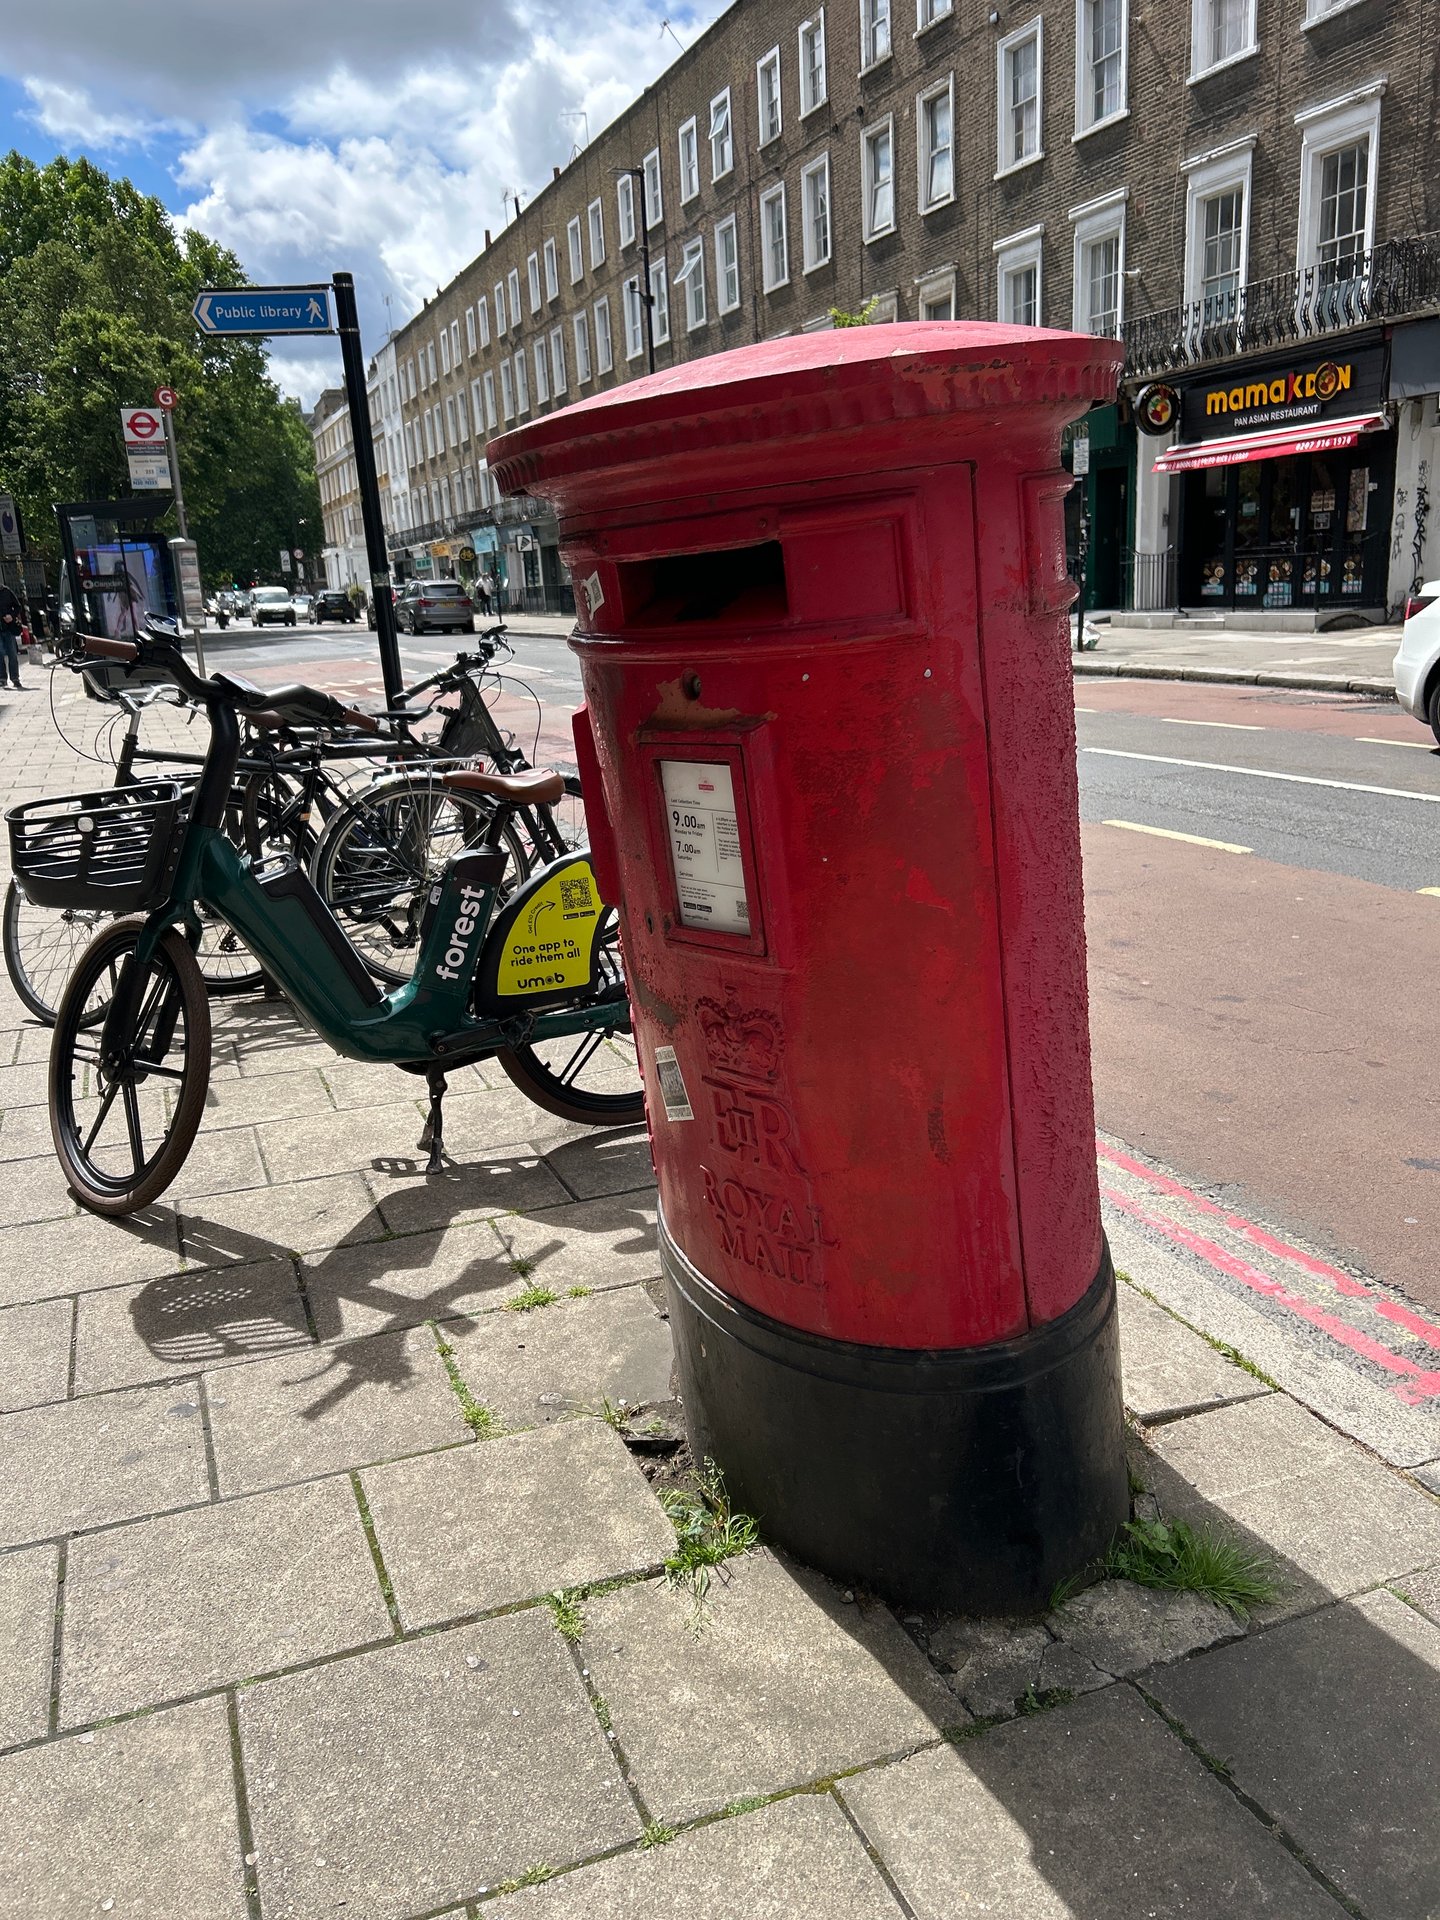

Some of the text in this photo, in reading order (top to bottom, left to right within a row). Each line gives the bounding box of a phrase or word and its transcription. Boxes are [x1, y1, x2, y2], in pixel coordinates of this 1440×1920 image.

[215, 305, 302, 319] Public library
[158, 390, 173, 405] G
[1234, 404, 1319, 427] PAN ASIAN RESTAURANT
[1333, 435, 1352, 446] 1970
[436, 885, 486, 980] forest
[512, 938, 575, 955] One app to
[510, 948, 581, 968] ride them all
[700, 1164, 840, 1251] ROYAL
[716, 1213, 829, 1291] MAIL
